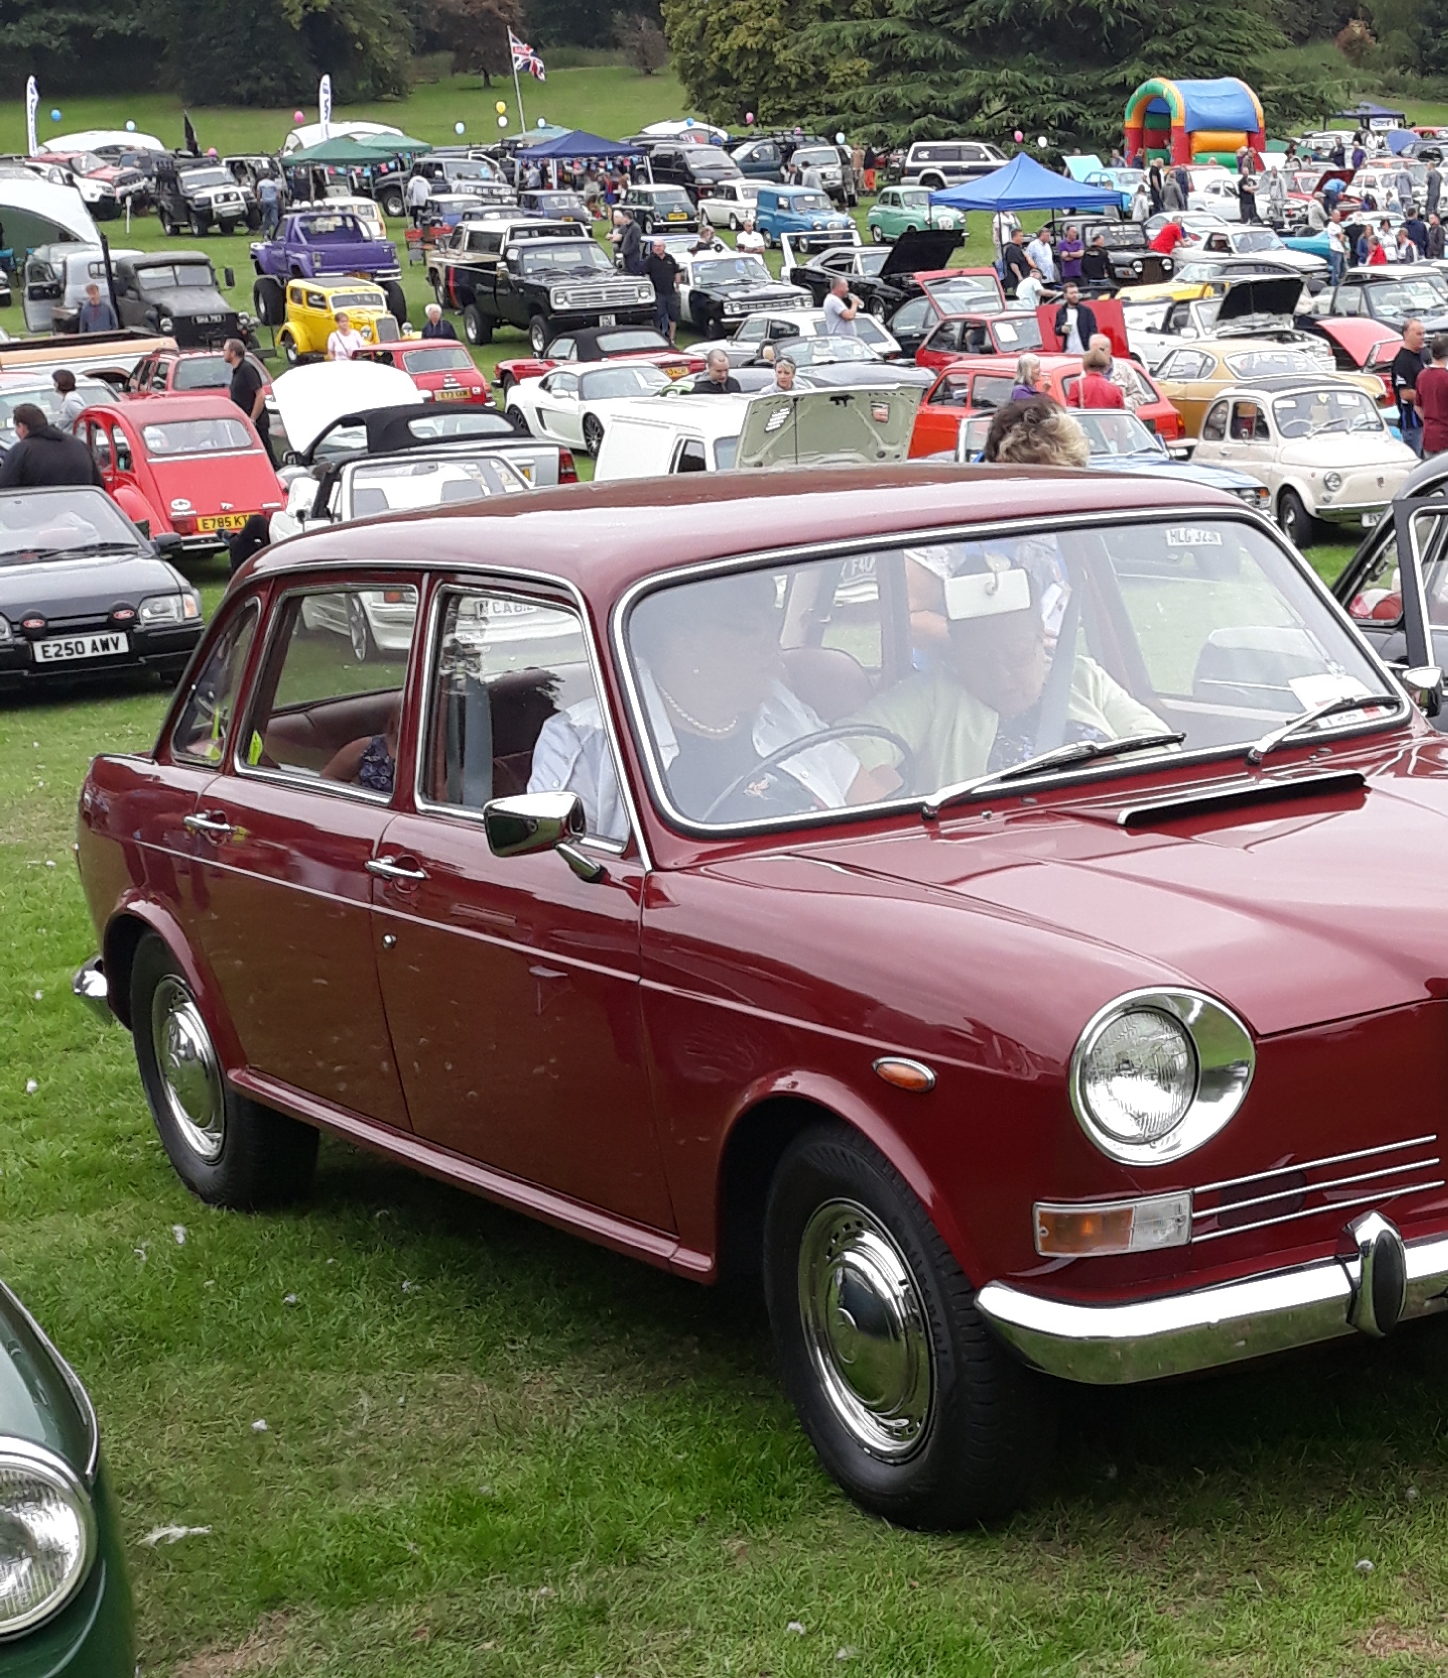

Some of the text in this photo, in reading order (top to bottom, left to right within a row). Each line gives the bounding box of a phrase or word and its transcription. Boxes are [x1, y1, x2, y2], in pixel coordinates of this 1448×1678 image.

[202, 514, 249, 530] E785 KT
[41, 635, 120, 659] E250 AWV
